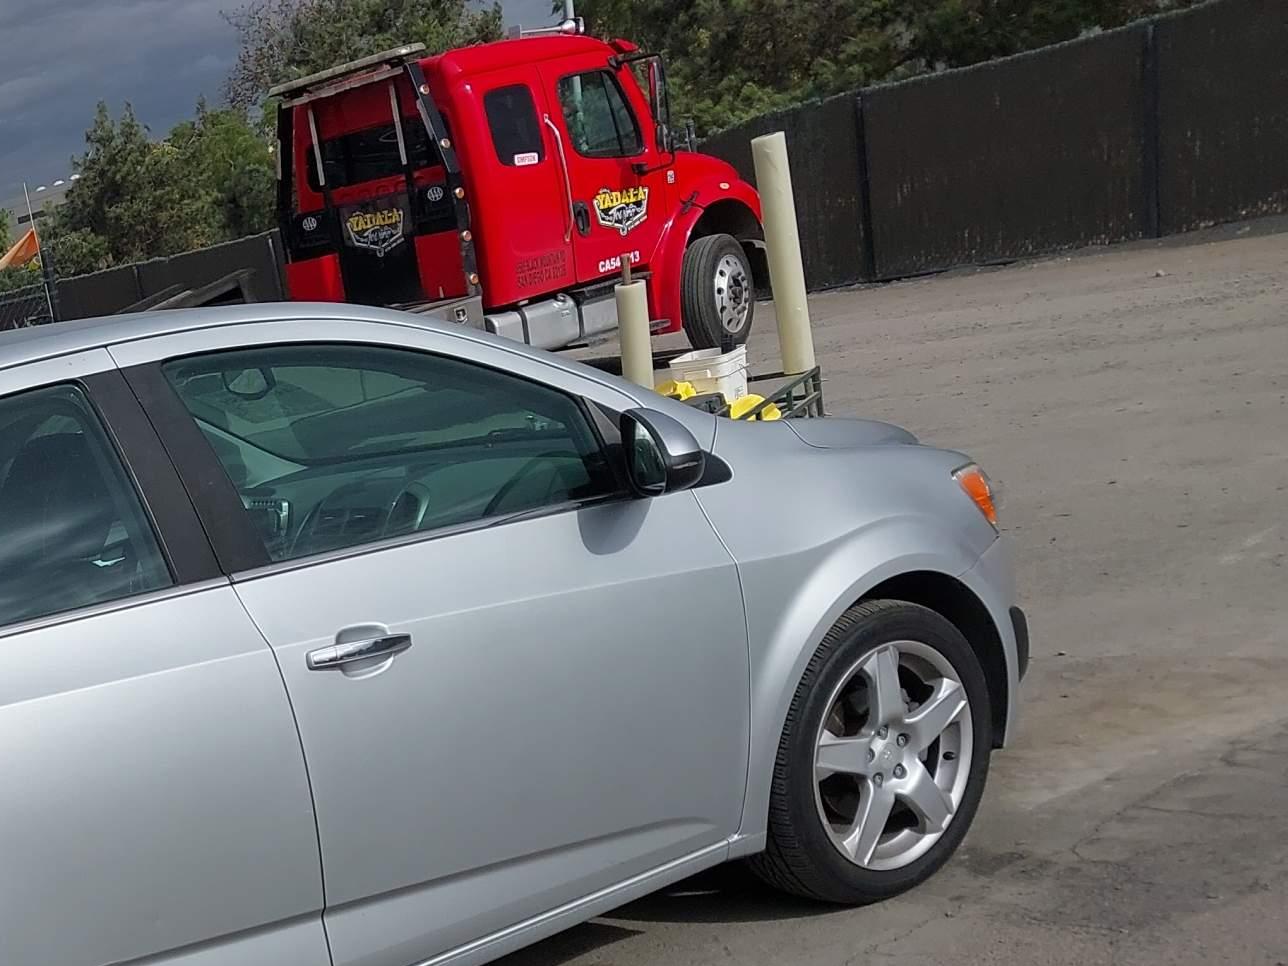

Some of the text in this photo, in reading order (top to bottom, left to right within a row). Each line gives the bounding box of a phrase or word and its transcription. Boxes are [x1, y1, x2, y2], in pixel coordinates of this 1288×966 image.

[596, 186, 646, 210] YADALA
[349, 207, 401, 232] YADALA
[599, 250, 640, 273] CA5413
